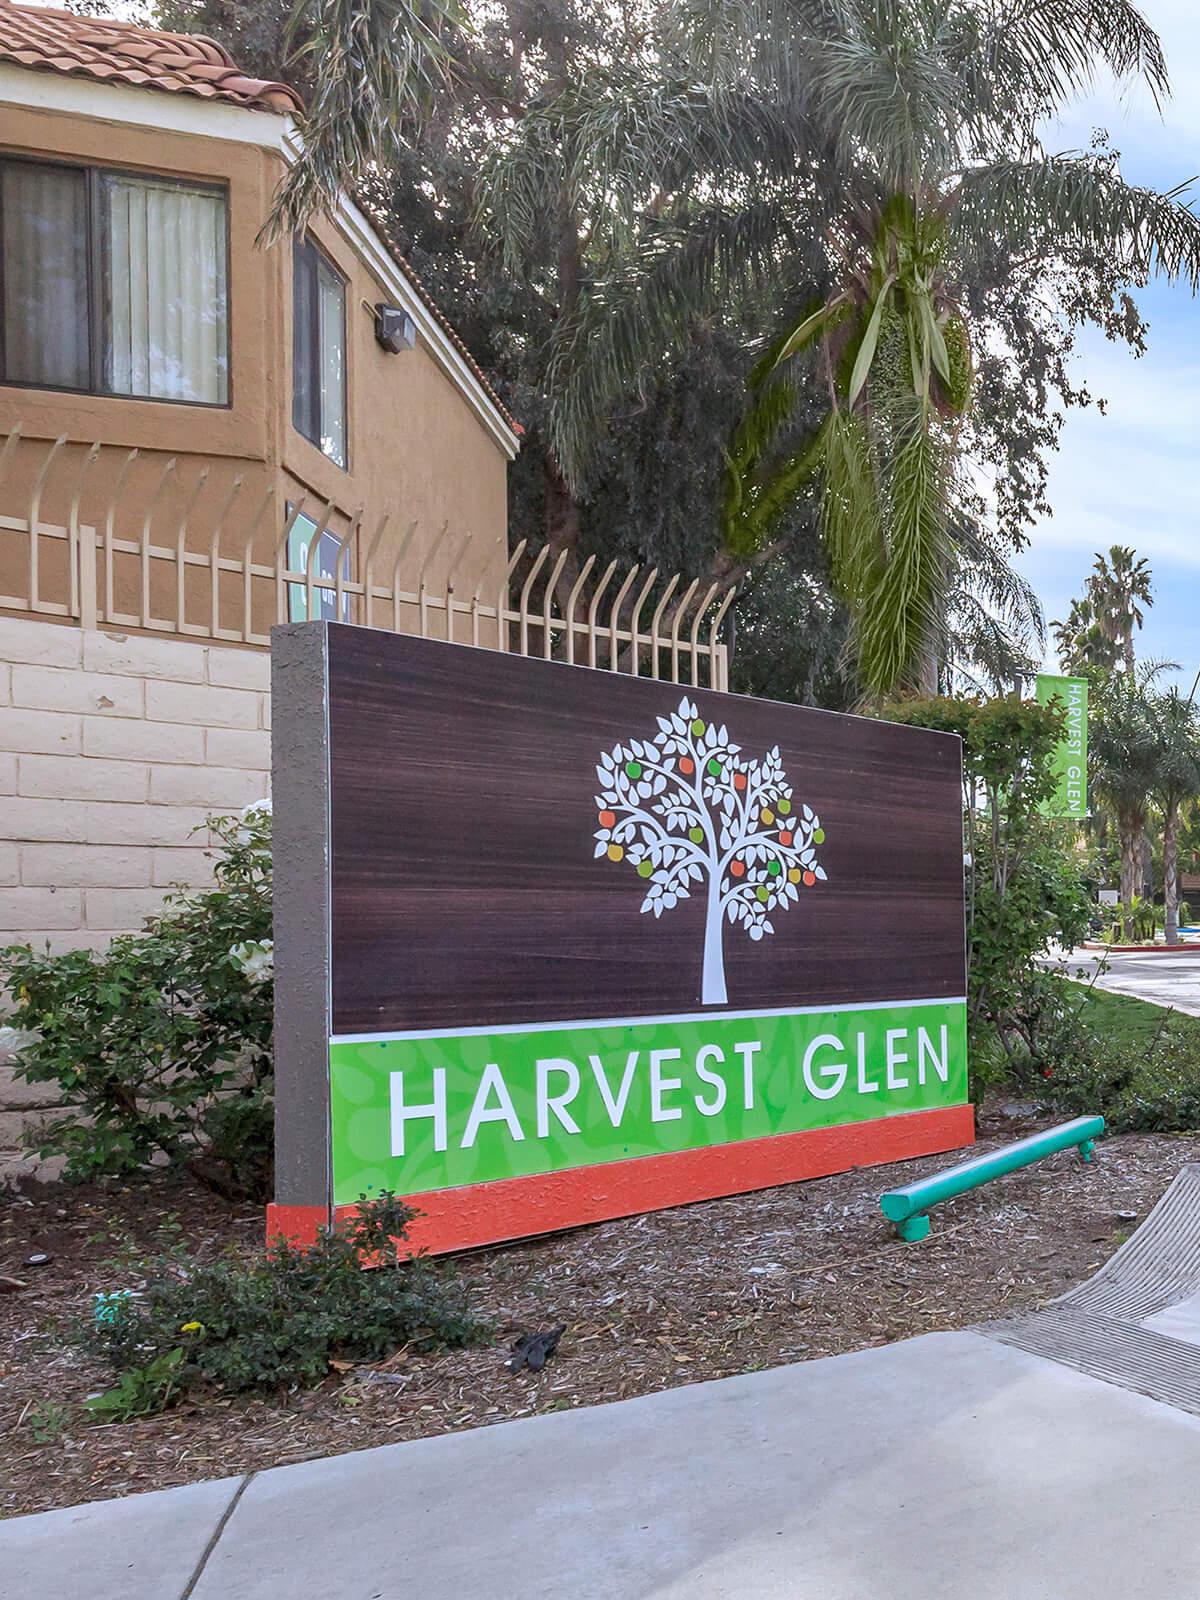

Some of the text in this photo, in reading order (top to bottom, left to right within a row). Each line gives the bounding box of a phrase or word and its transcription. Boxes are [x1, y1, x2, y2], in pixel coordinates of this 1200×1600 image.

[1067, 684, 1082, 812] HARVEST GLEN
[389, 1024, 949, 1157] HARVEST GLEN
